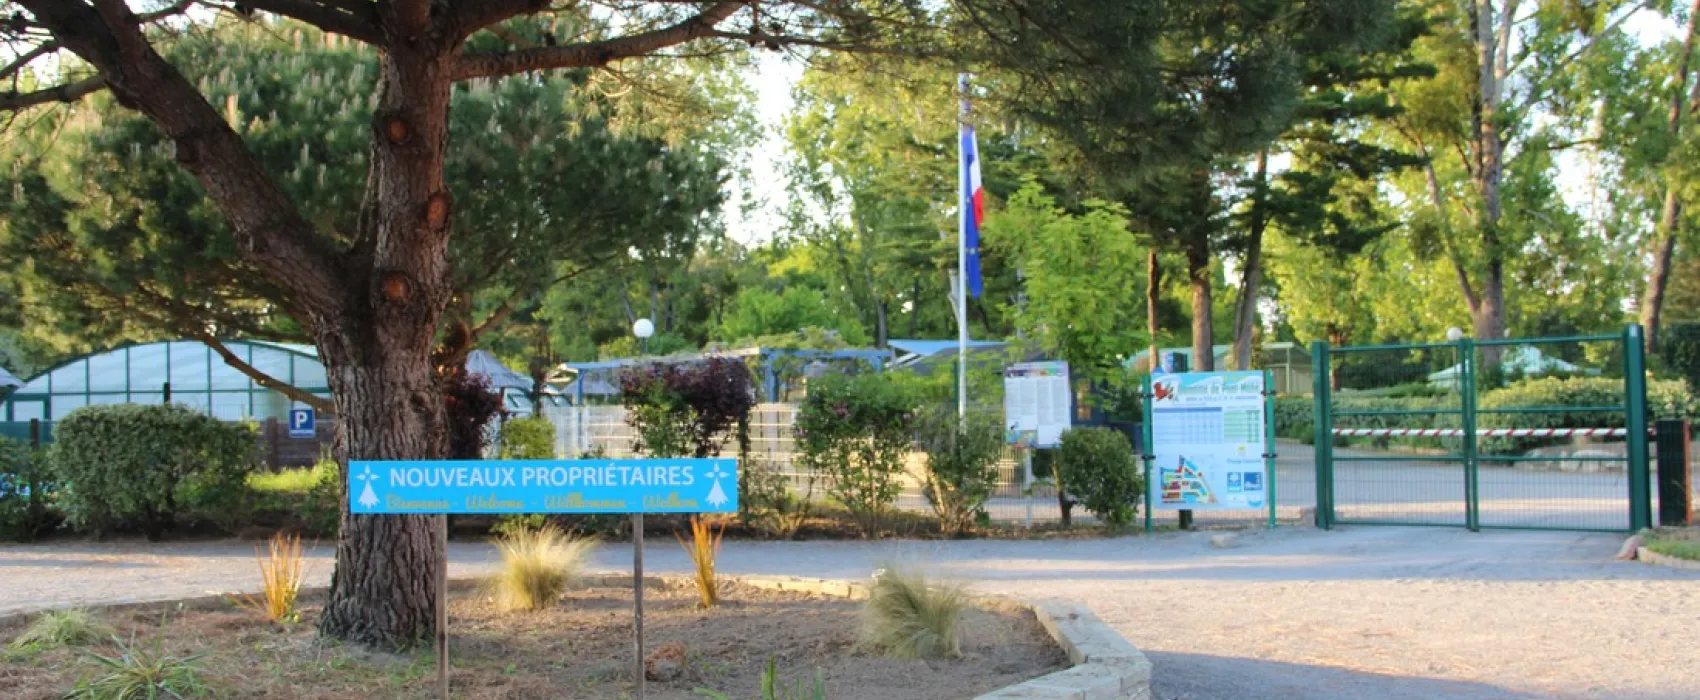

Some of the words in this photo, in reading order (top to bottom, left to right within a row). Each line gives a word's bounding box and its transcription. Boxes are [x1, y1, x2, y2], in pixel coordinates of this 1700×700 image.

[296, 411, 308, 428] P
[389, 466, 516, 488] NOUVEAUX
[522, 463, 695, 487] PROPRIÉTAIRES
